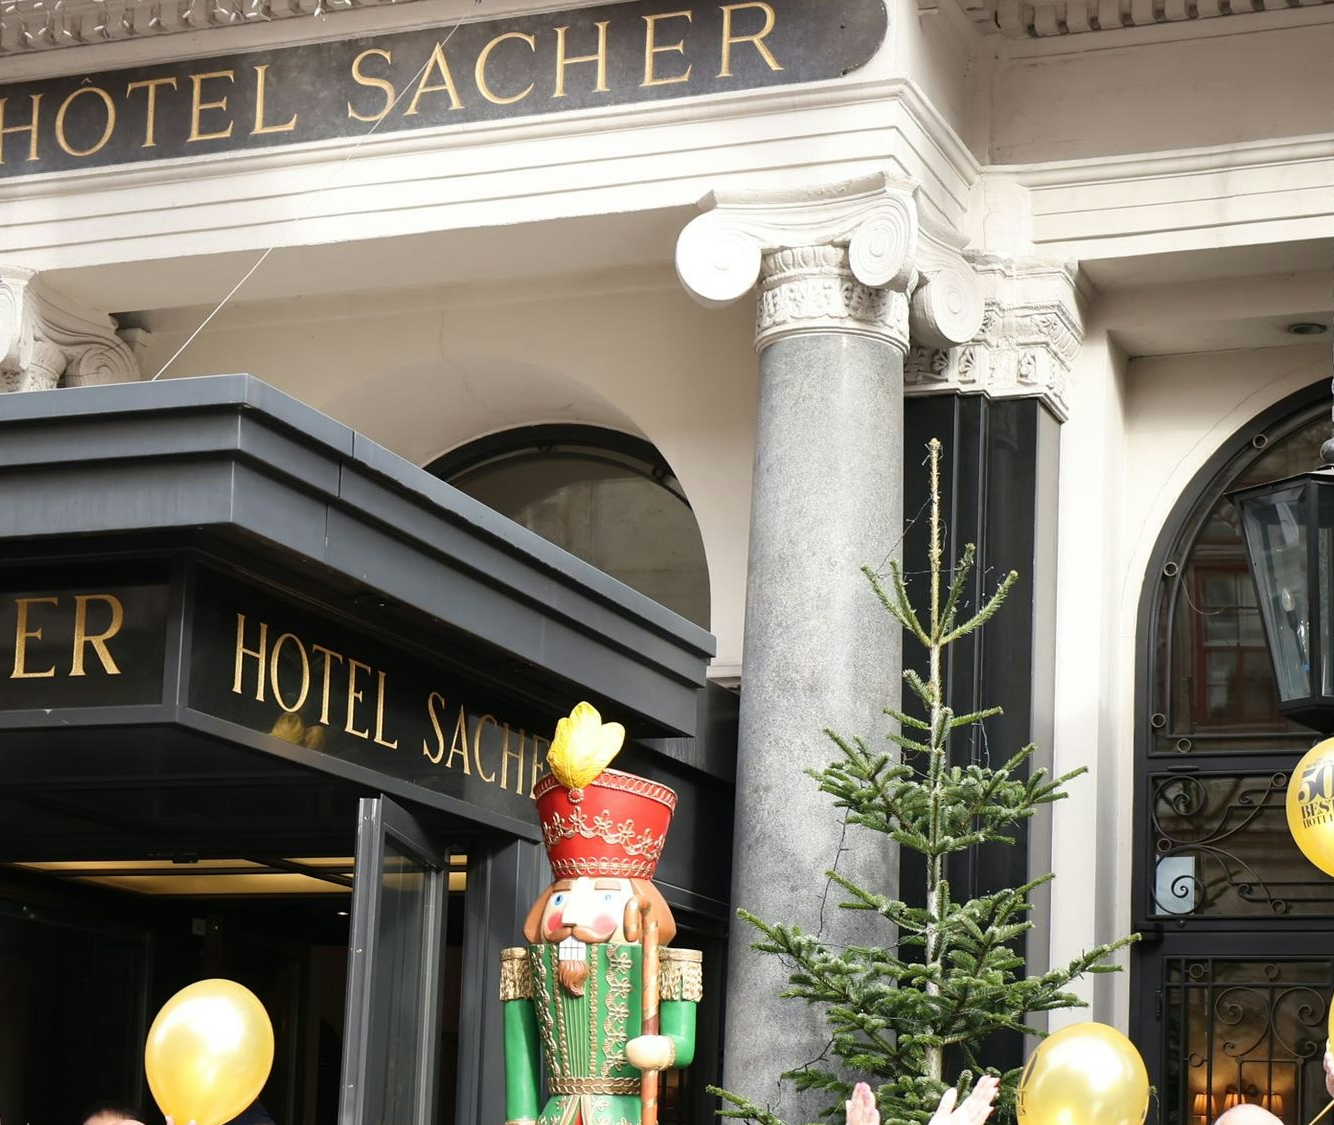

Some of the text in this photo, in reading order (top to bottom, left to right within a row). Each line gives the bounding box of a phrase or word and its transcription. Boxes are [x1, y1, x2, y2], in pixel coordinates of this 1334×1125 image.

[347, 1, 786, 122] SACHER
[232, 612, 551, 800] HOTEL SACHE
